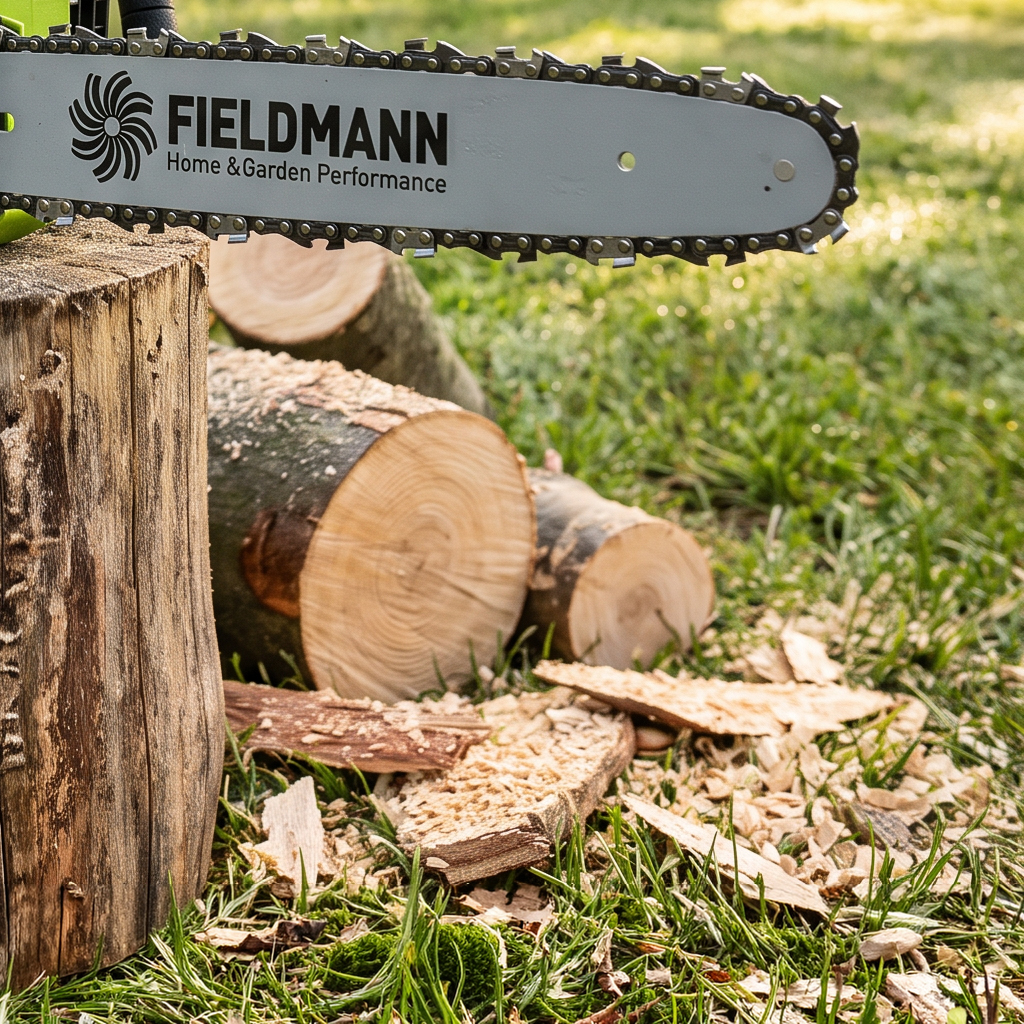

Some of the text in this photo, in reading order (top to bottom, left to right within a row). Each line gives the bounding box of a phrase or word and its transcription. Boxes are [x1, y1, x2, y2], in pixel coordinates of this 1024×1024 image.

[168, 94, 448, 166] FIELDMANN
[167, 151, 221, 175] Home
[317, 163, 447, 194] Performance
